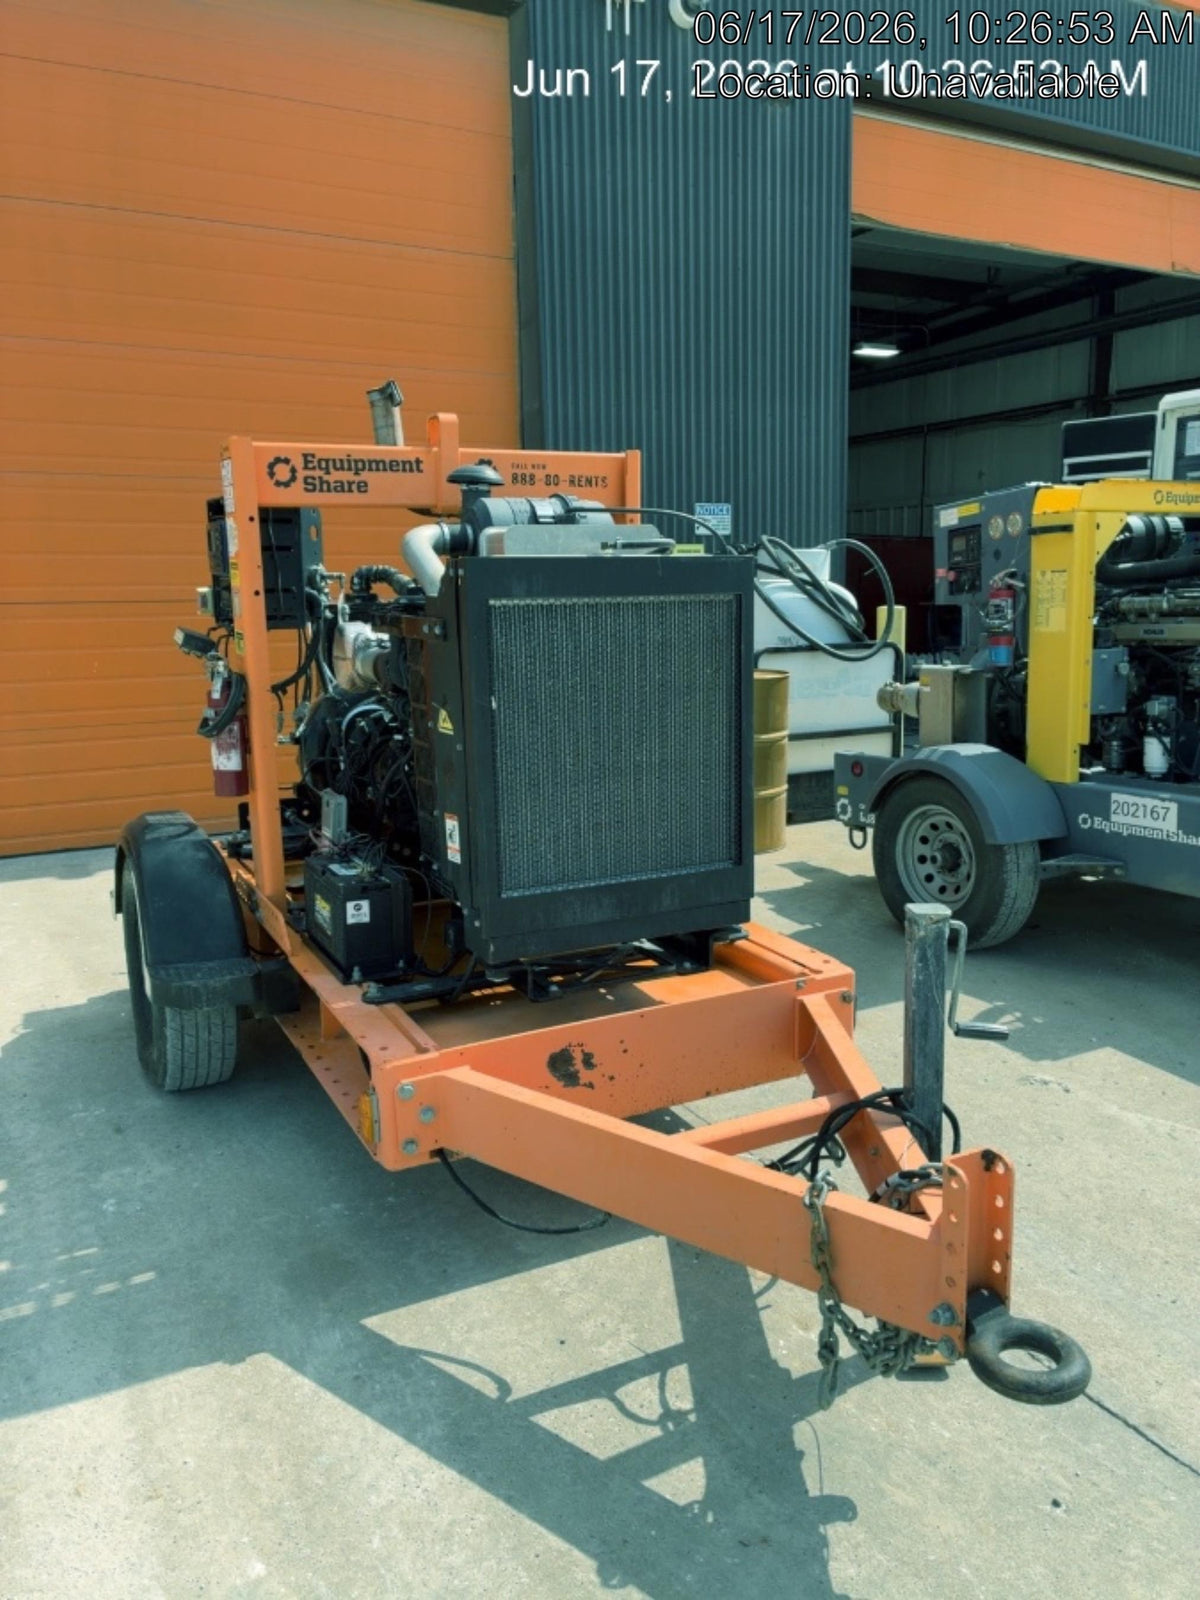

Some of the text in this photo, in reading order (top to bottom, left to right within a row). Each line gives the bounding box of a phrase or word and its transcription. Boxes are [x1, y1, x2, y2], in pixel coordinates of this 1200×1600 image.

[301, 453, 424, 475] Equipment
[303, 476, 369, 493] Share
[511, 472, 609, 489] 888-80-RENTS
[696, 505, 729, 515] NOTICE
[1111, 799, 1171, 822] 202167
